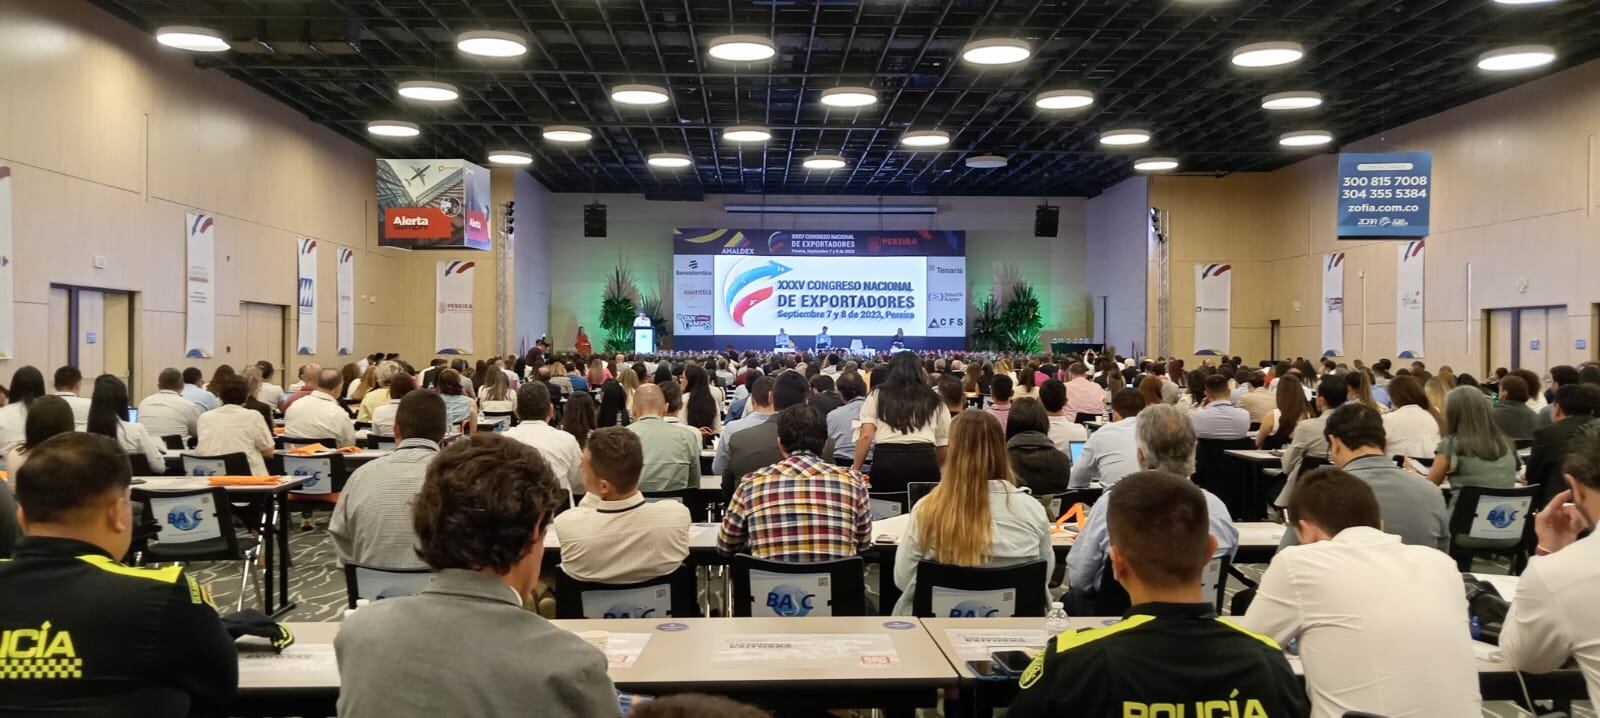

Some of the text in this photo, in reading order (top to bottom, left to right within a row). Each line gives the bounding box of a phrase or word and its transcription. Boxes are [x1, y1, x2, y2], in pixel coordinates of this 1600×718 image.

[1343, 176, 1428, 186] 300 815 7008
[1342, 189, 1426, 199] 304 355 5384
[1347, 203, 1419, 212] zofia.com.co
[393, 216, 429, 226] Alerta
[882, 238, 917, 246] PEREIRA
[777, 280, 914, 291] XXXV CONGRESO NACIONAL
[777, 294, 915, 308] DE EXPORTADORES
[777, 309, 825, 319] Septiembre
[826, 310, 832, 318] 7
[833, 312, 839, 320] y
[841, 310, 847, 318] 8
[848, 310, 859, 318] de
[885, 311, 915, 319] Pereira
